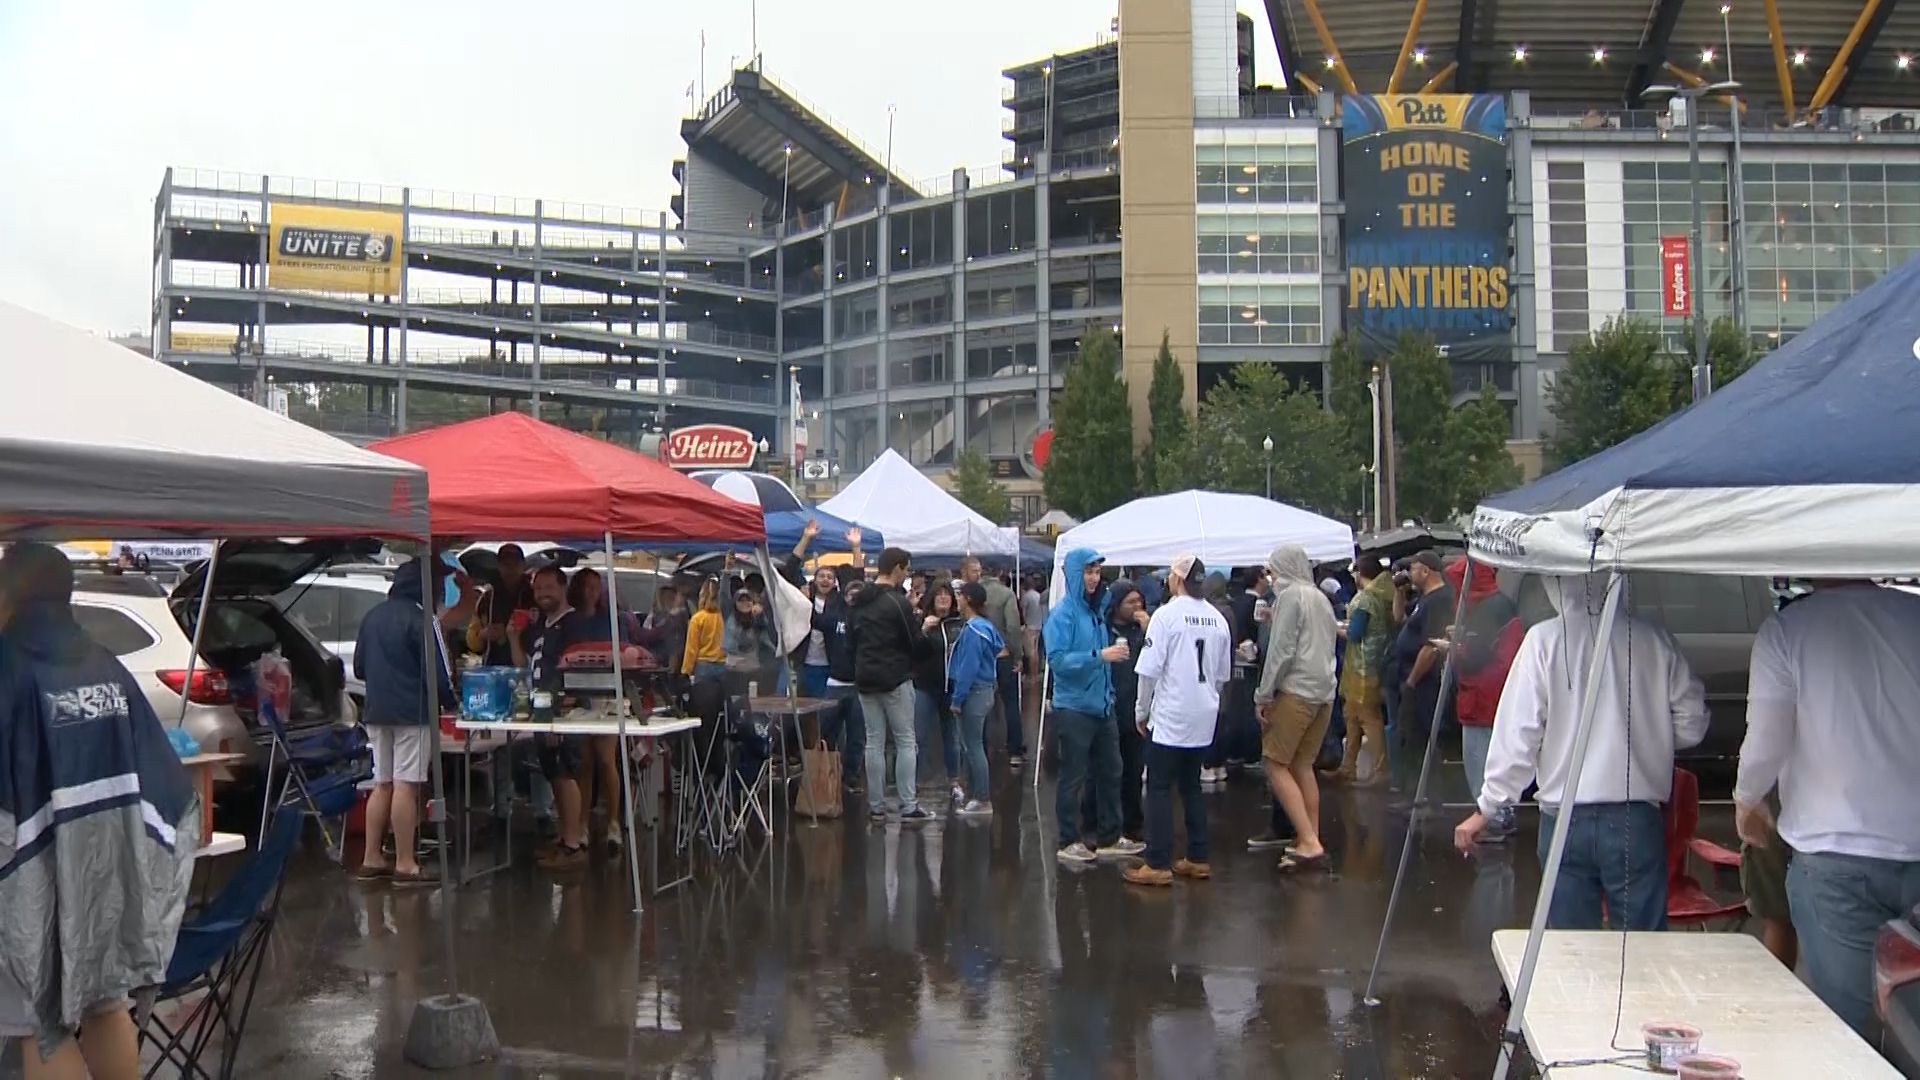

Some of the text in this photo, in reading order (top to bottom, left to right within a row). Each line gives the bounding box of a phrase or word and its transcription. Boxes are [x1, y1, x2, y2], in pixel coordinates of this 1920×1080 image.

[1397, 97, 1448, 124] Pitt
[1380, 141, 1471, 172] HOME
[1407, 172, 1446, 197] OF
[1398, 202, 1456, 228] THE
[285, 237, 361, 256] UNITE
[288, 231, 362, 241] STEELERS NATION
[1348, 265, 1508, 309] PANTHERS
[1672, 263, 1687, 310] Explore
[671, 434, 748, 459] Heinz
[149, 547, 201, 556] PENN STATE
[1185, 615, 1218, 627] PENN STATE
[1195, 638, 1206, 684] 1
[78, 683, 121, 702] PENN
[81, 697, 129, 718] STATE
